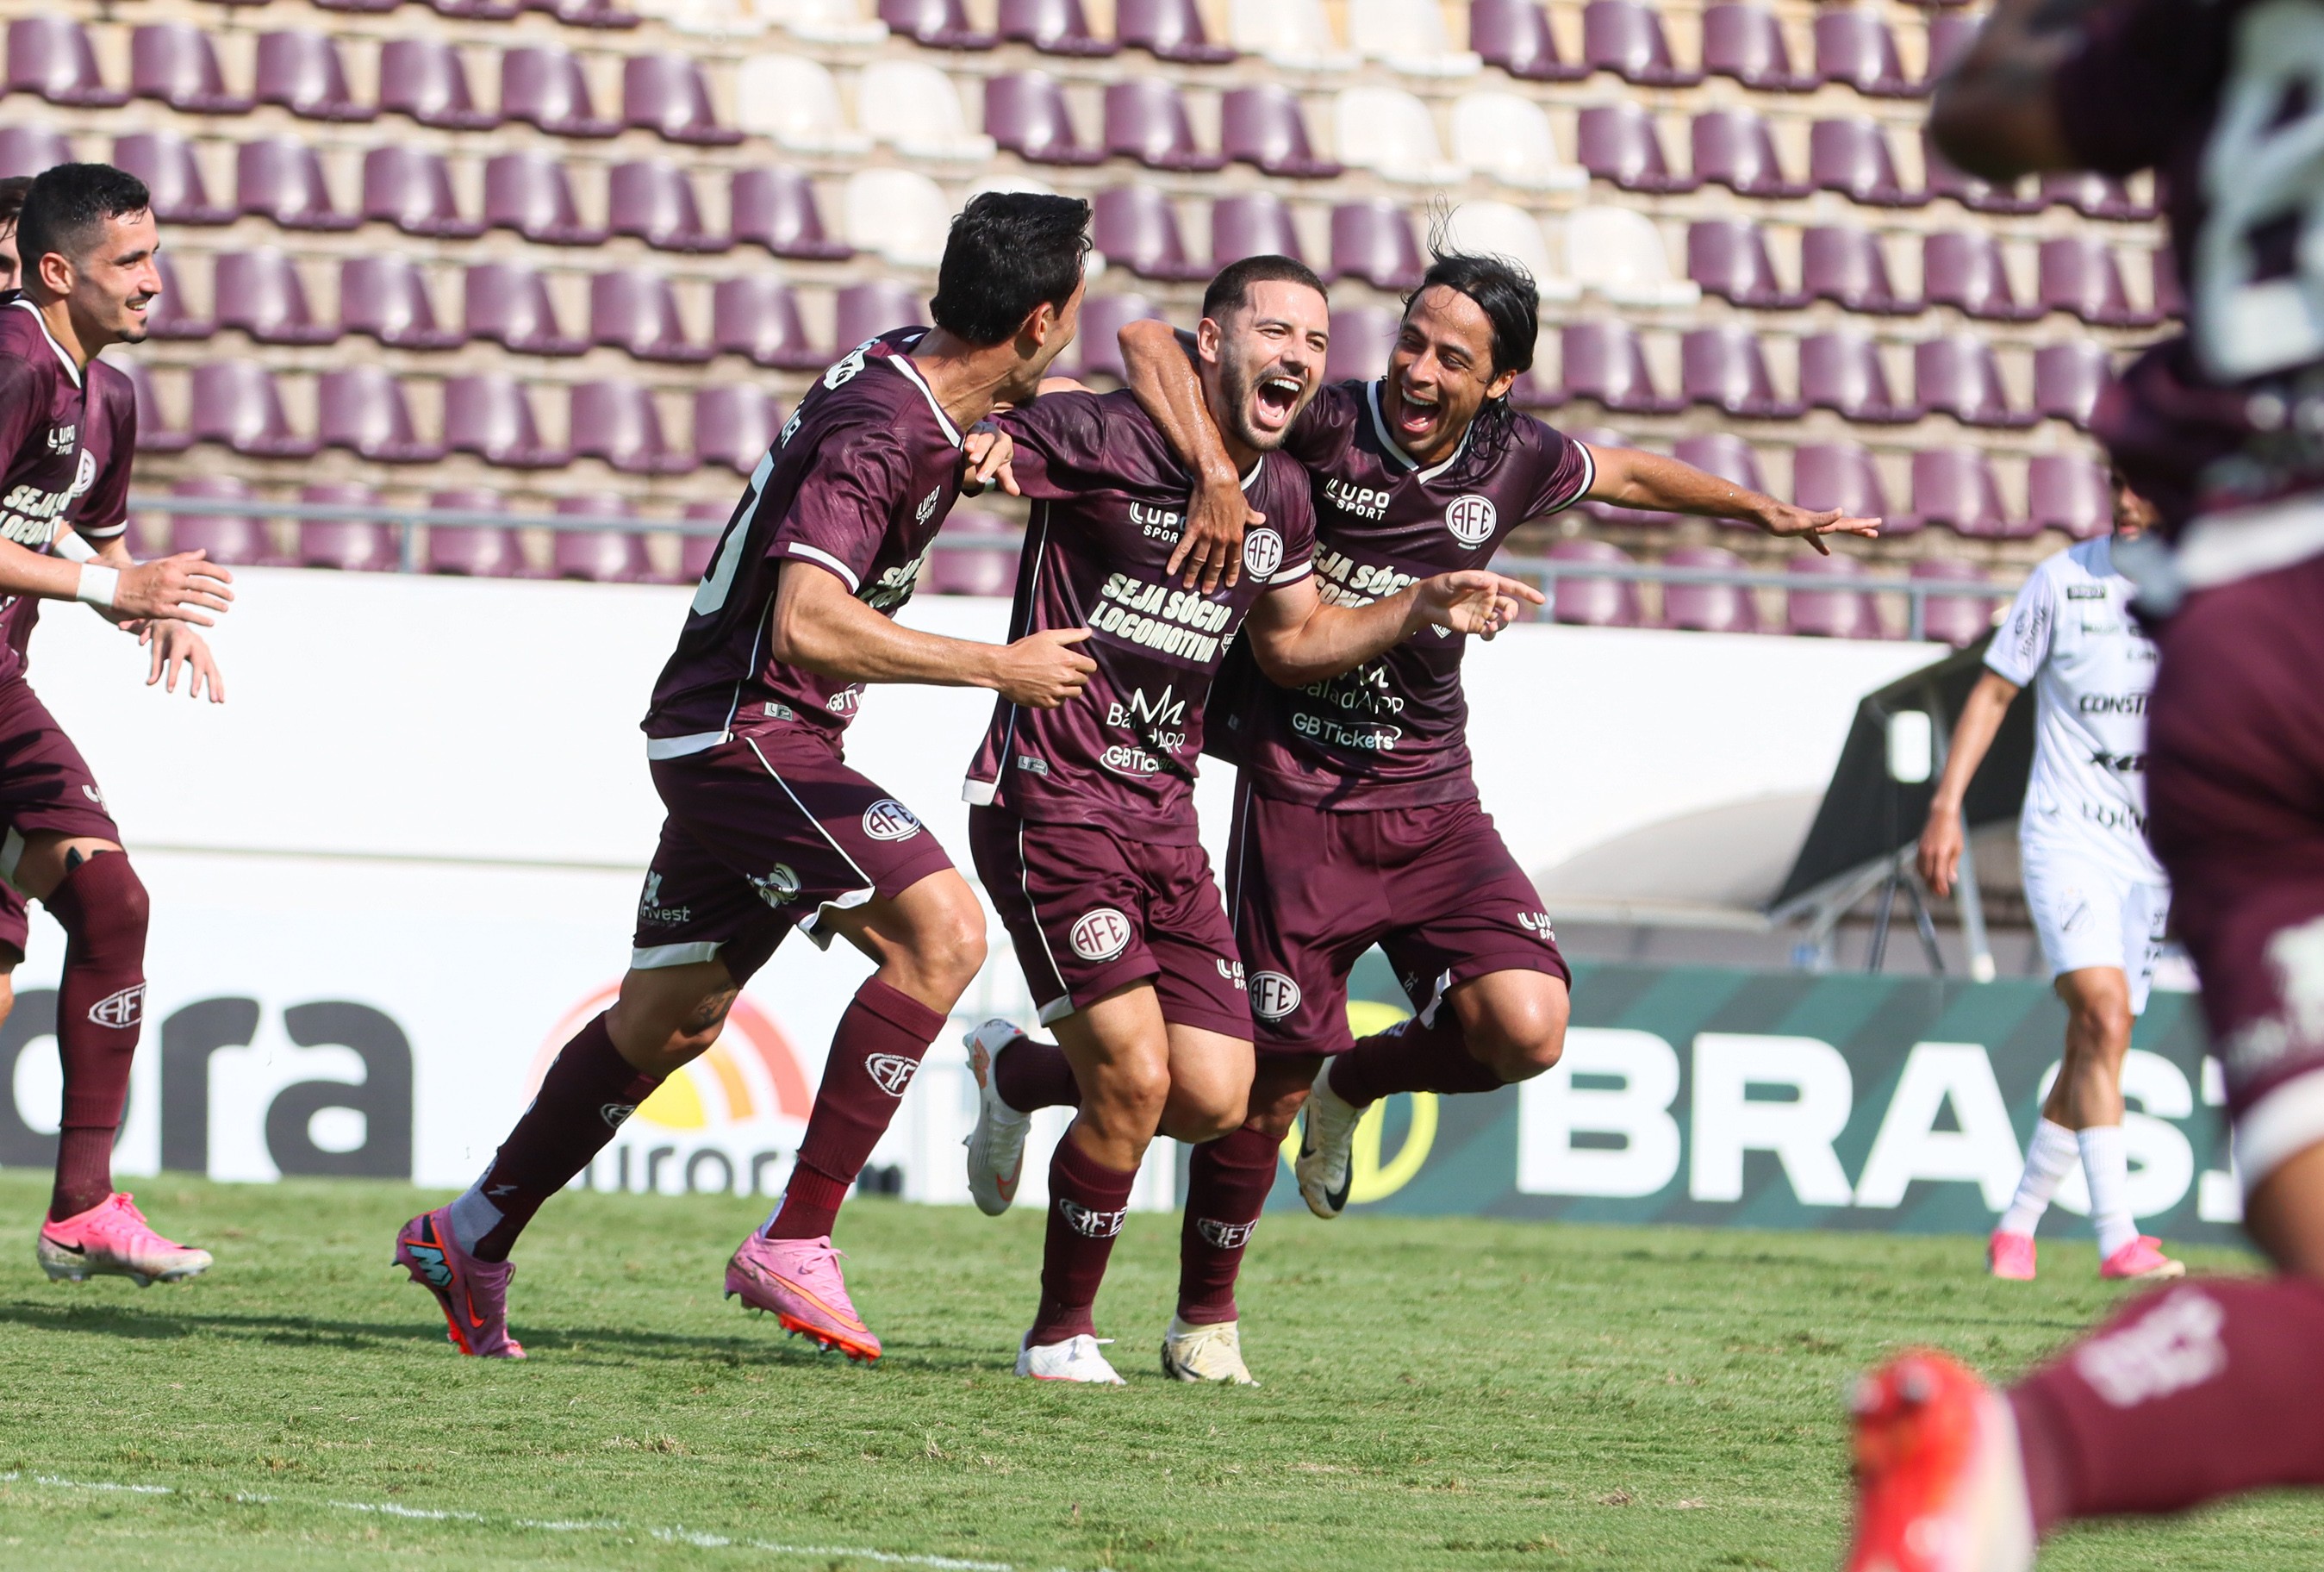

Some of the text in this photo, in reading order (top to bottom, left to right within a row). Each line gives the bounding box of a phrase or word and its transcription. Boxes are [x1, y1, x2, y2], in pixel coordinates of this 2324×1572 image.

[1325, 477, 1391, 509] LUPO
[1336, 498, 1386, 521] SPORT
[1451, 501, 1492, 535] AFE
[1247, 534, 1280, 569] AFE
[1349, 565, 1421, 598] SÓC
[1101, 572, 1232, 633] SEJA SÓCIO
[1087, 601, 1220, 663] LOCOMOTIVA
[1293, 712, 1395, 750] GBTickets
[869, 802, 916, 834] AFE
[1077, 915, 1124, 953] AFE
[1251, 977, 1291, 1012] AFE
